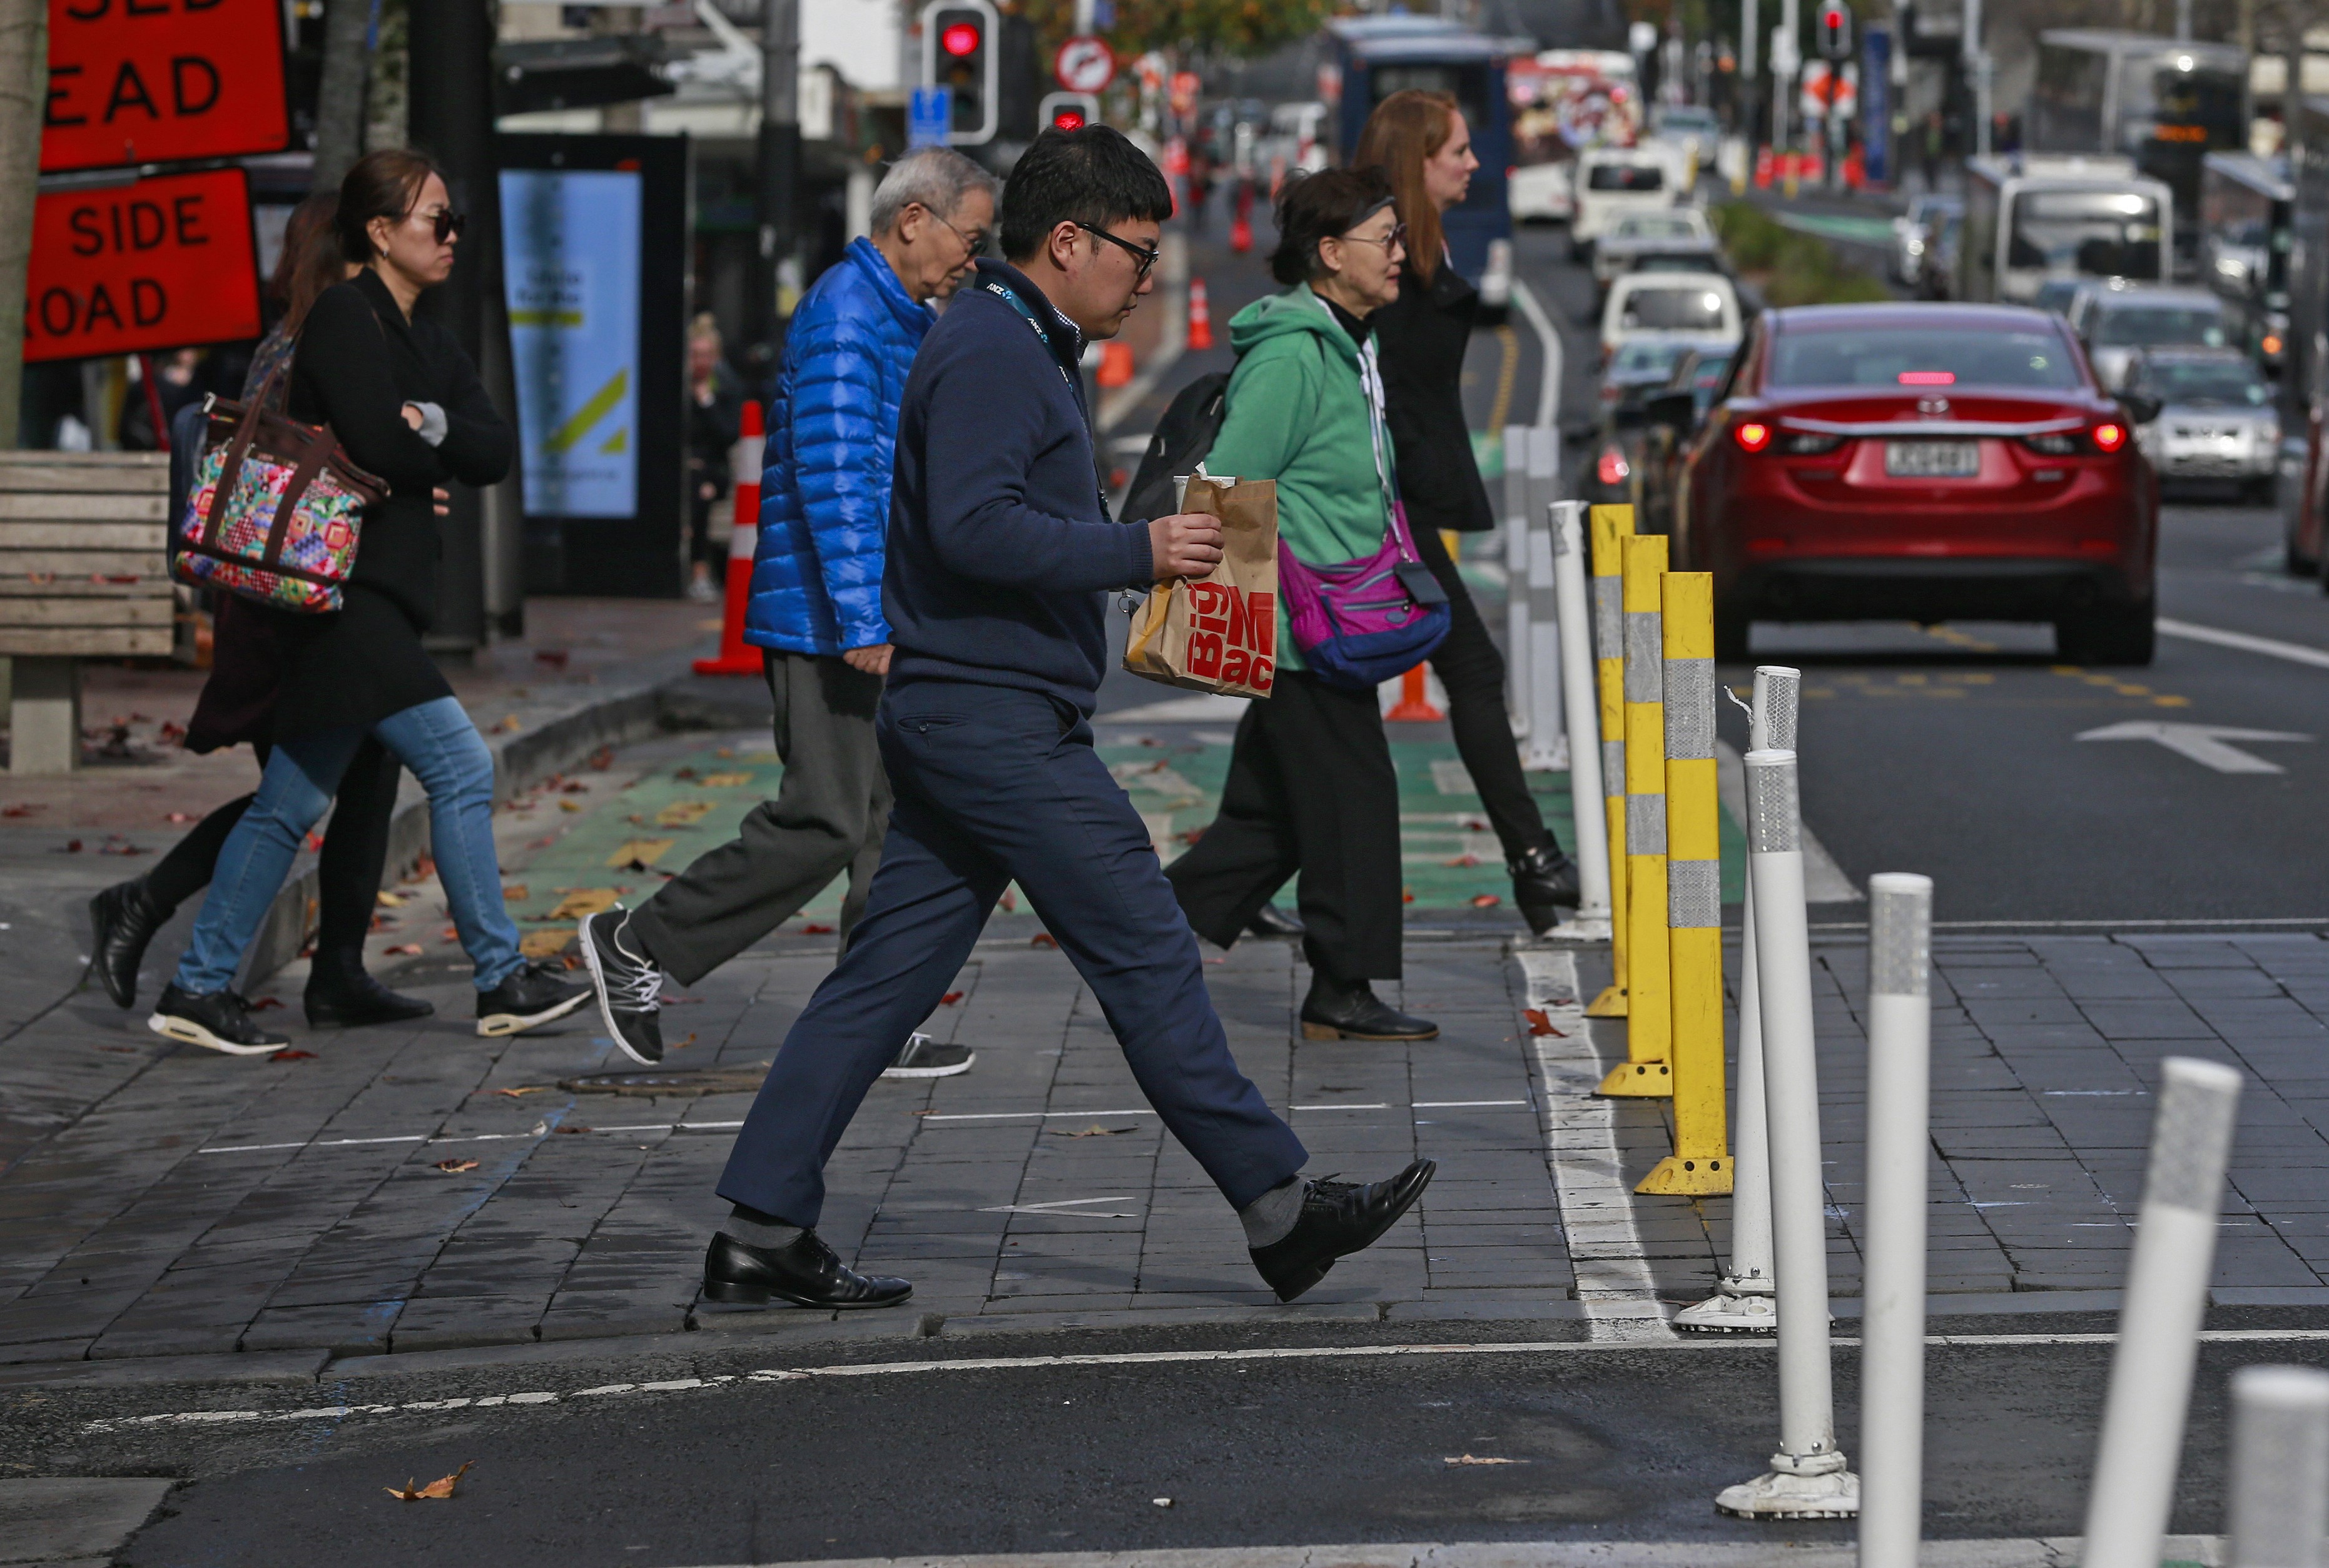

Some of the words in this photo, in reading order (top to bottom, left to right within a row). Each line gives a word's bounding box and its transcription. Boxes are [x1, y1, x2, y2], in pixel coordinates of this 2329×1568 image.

[69, 195, 210, 257] SIDE
[25, 277, 168, 339] OAD
[987, 283, 1005, 296] ANZ
[1027, 318, 1043, 335] ANZ
[1186, 581, 1229, 680] Big
